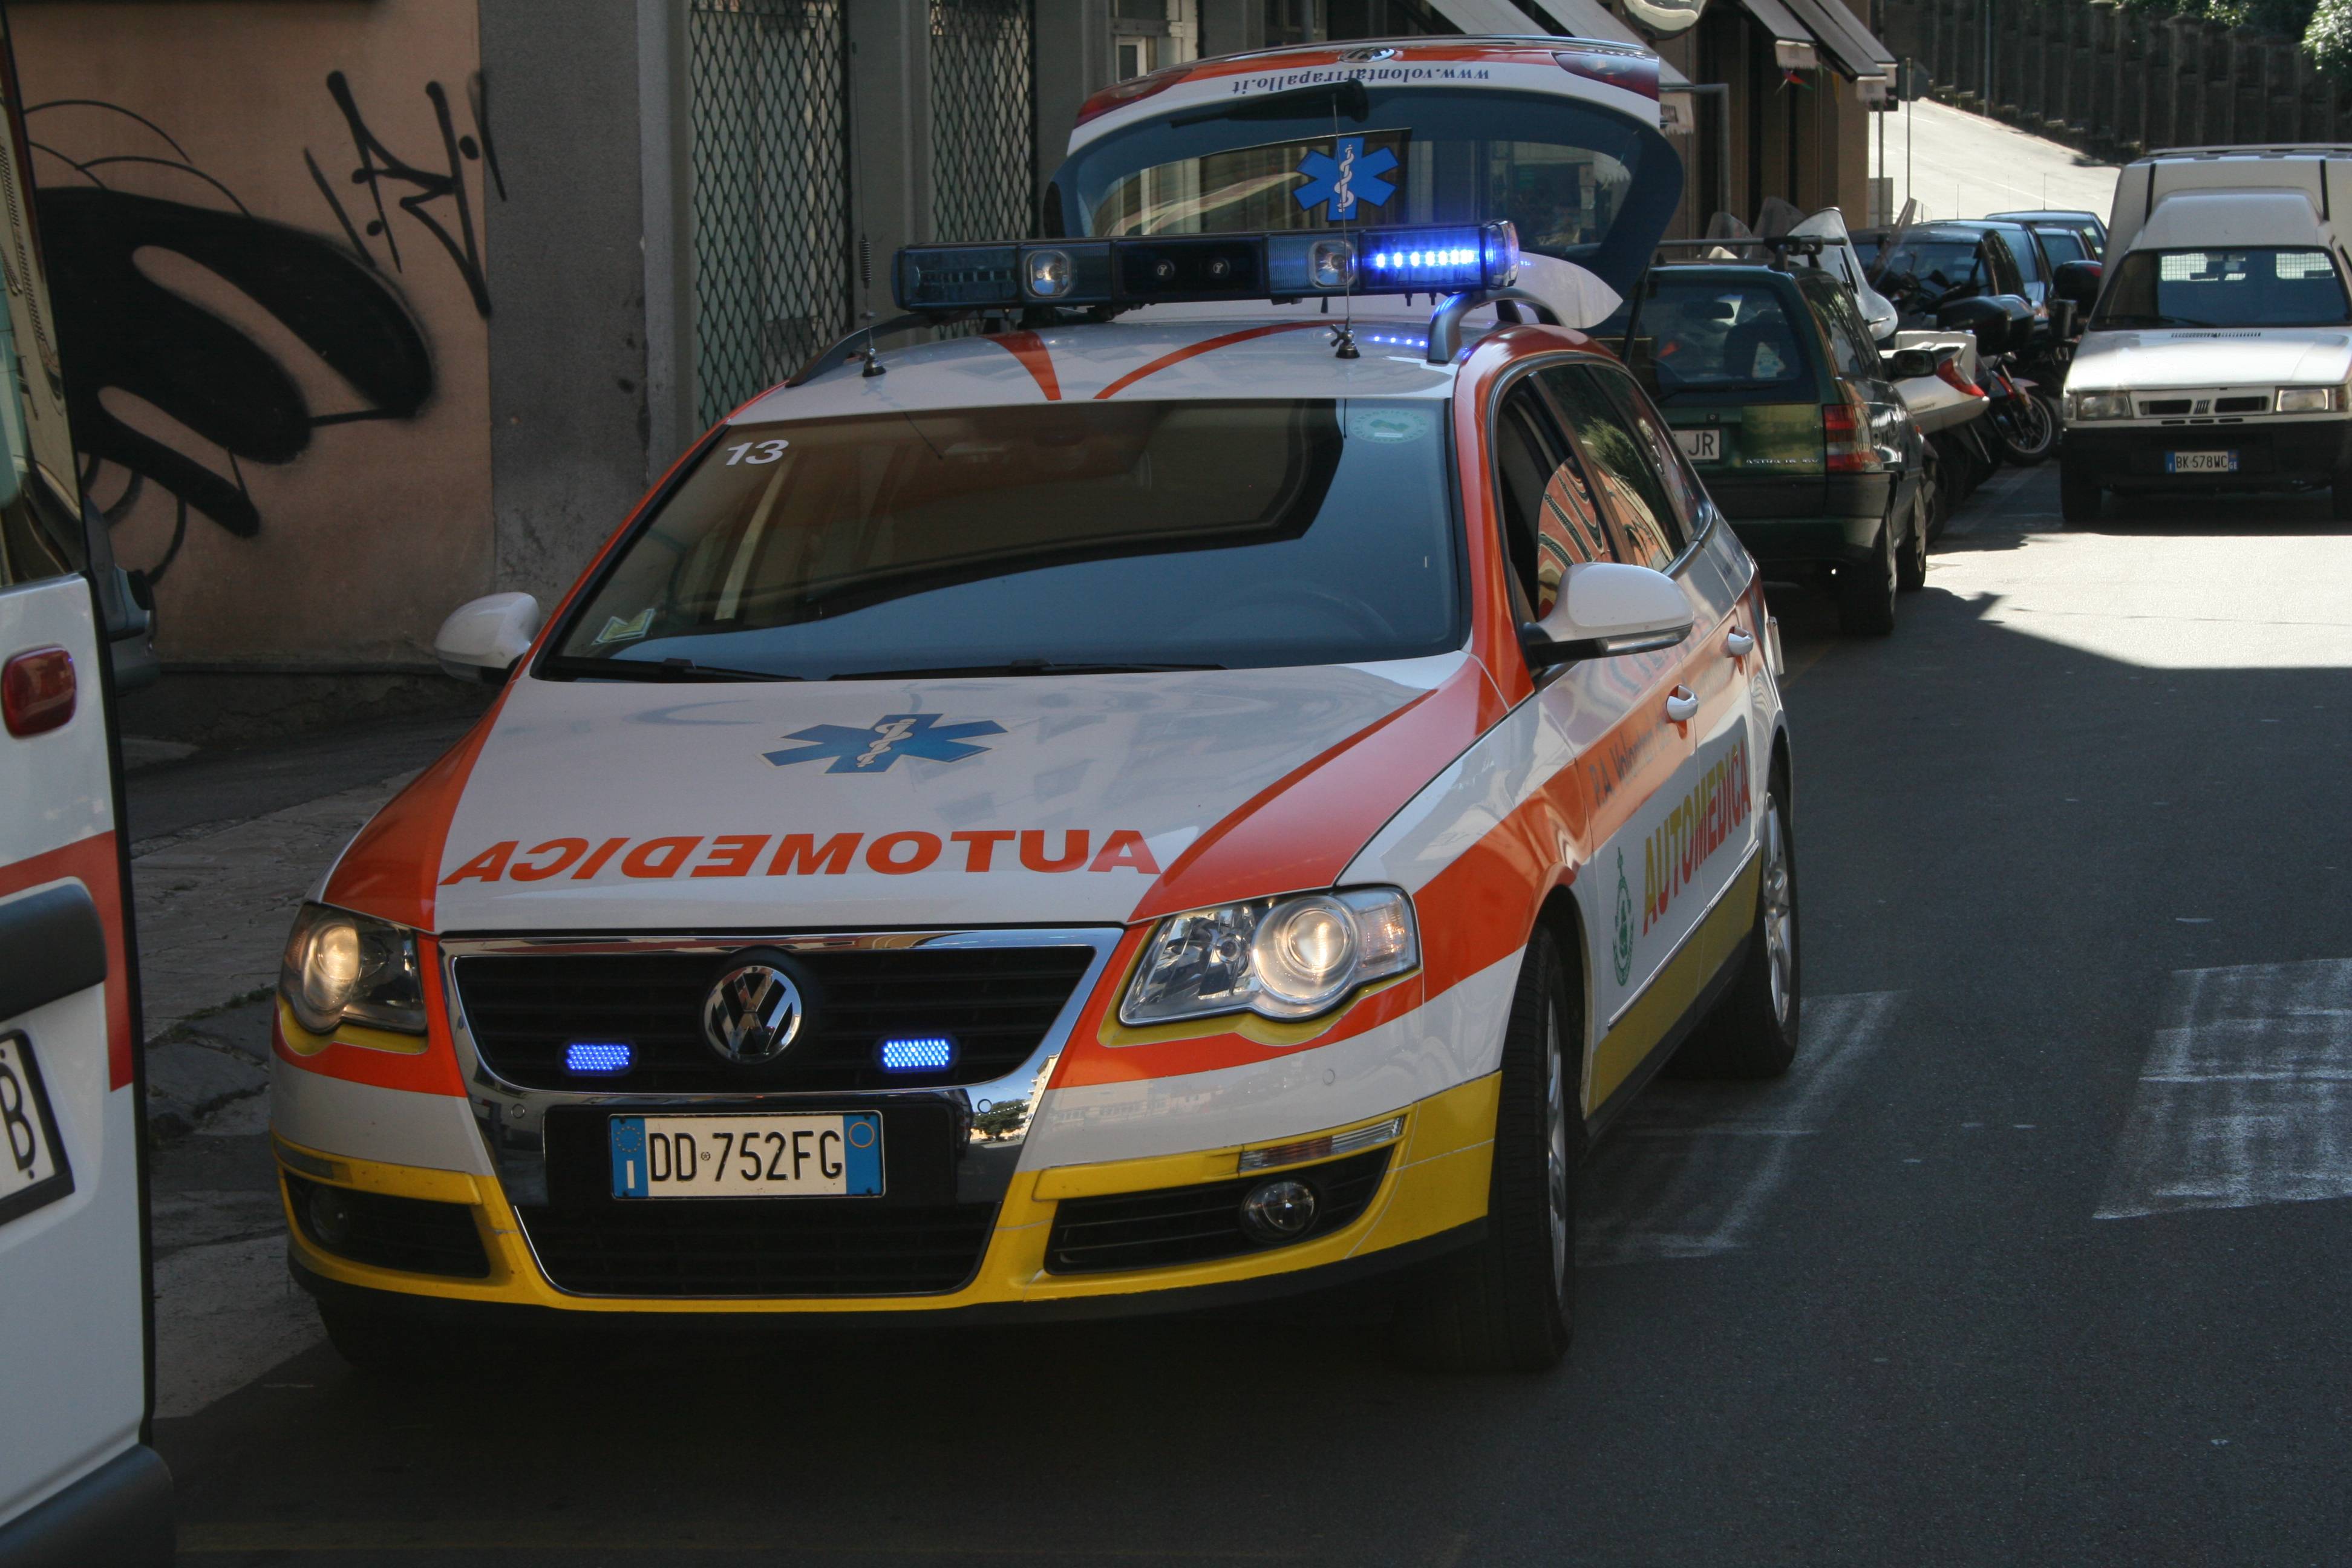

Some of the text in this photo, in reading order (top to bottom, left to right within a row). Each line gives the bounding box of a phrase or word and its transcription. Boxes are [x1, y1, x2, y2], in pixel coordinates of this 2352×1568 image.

[726, 440, 789, 465] 13
[2176, 456, 2189, 468] BK
[1643, 736, 1752, 937] AUTOMEDICA
